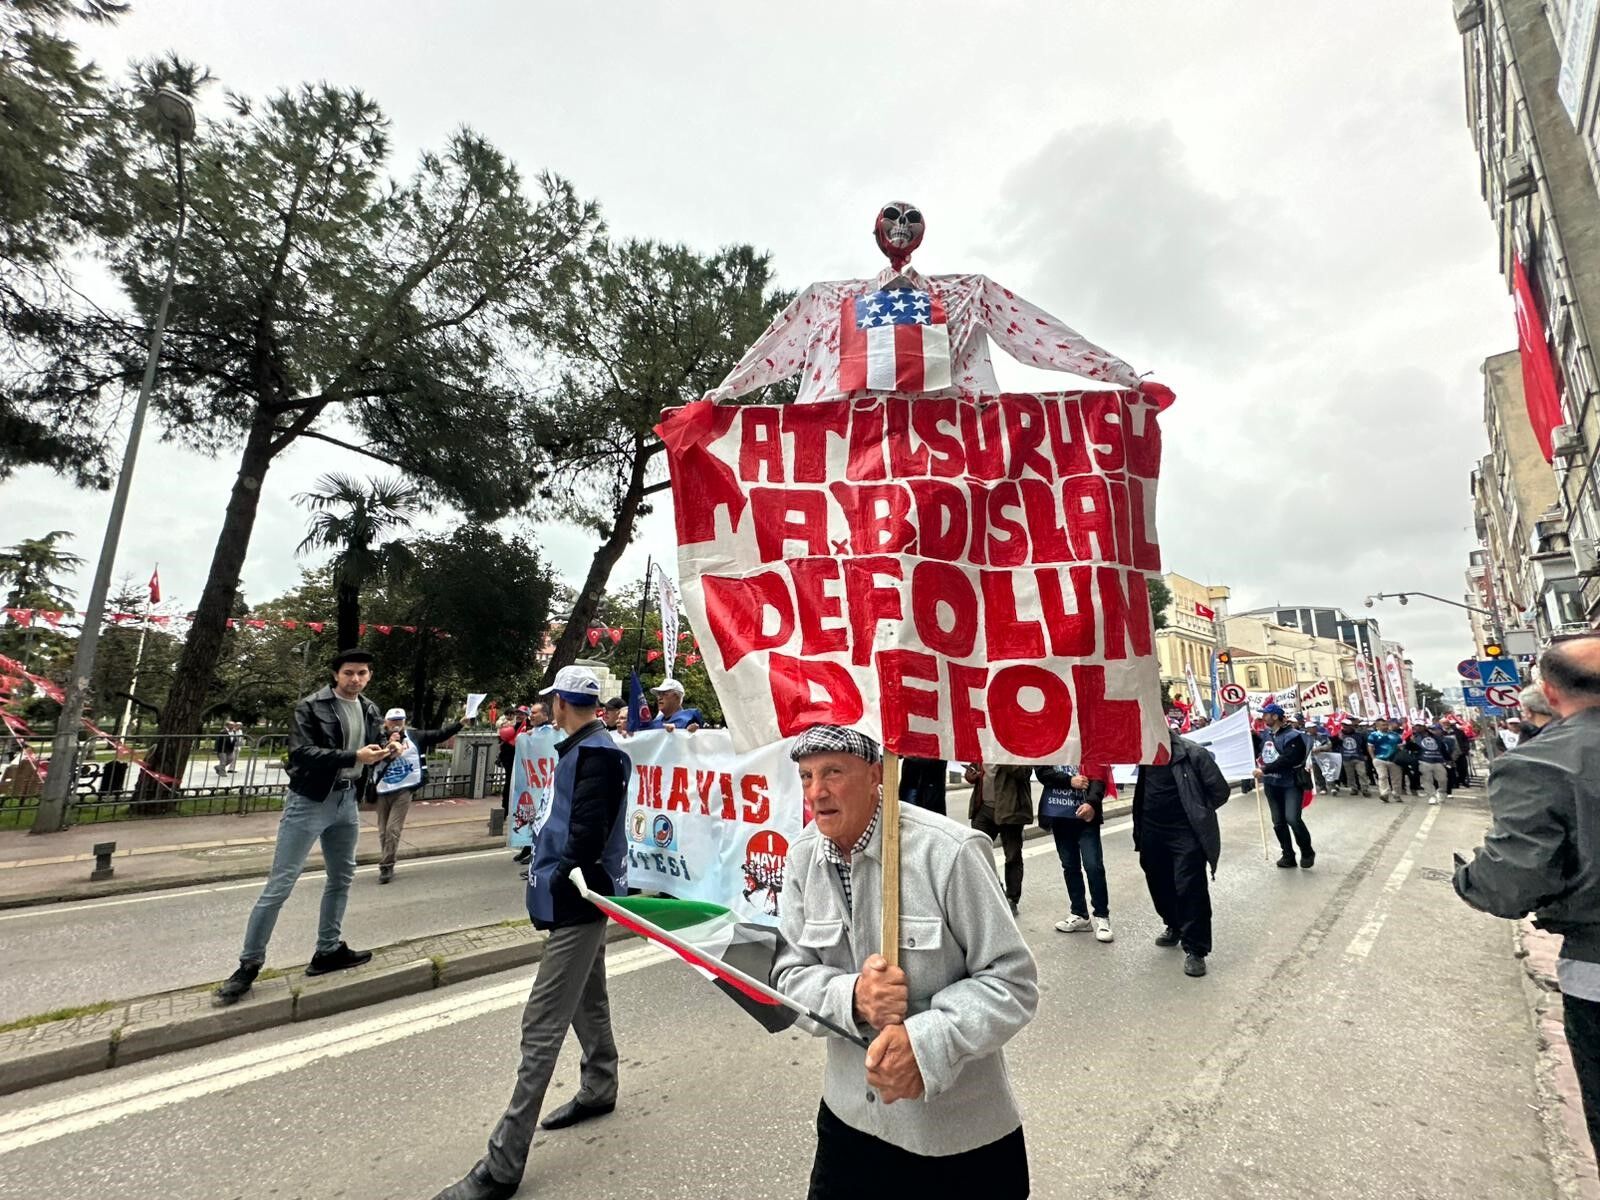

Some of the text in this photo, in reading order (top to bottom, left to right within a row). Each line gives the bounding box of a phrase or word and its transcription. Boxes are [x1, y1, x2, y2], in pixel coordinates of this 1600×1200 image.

[701, 556, 1152, 671] DEFOLUN
[769, 649, 1141, 765] DEFOL
[636, 765, 771, 824] MAYIS
